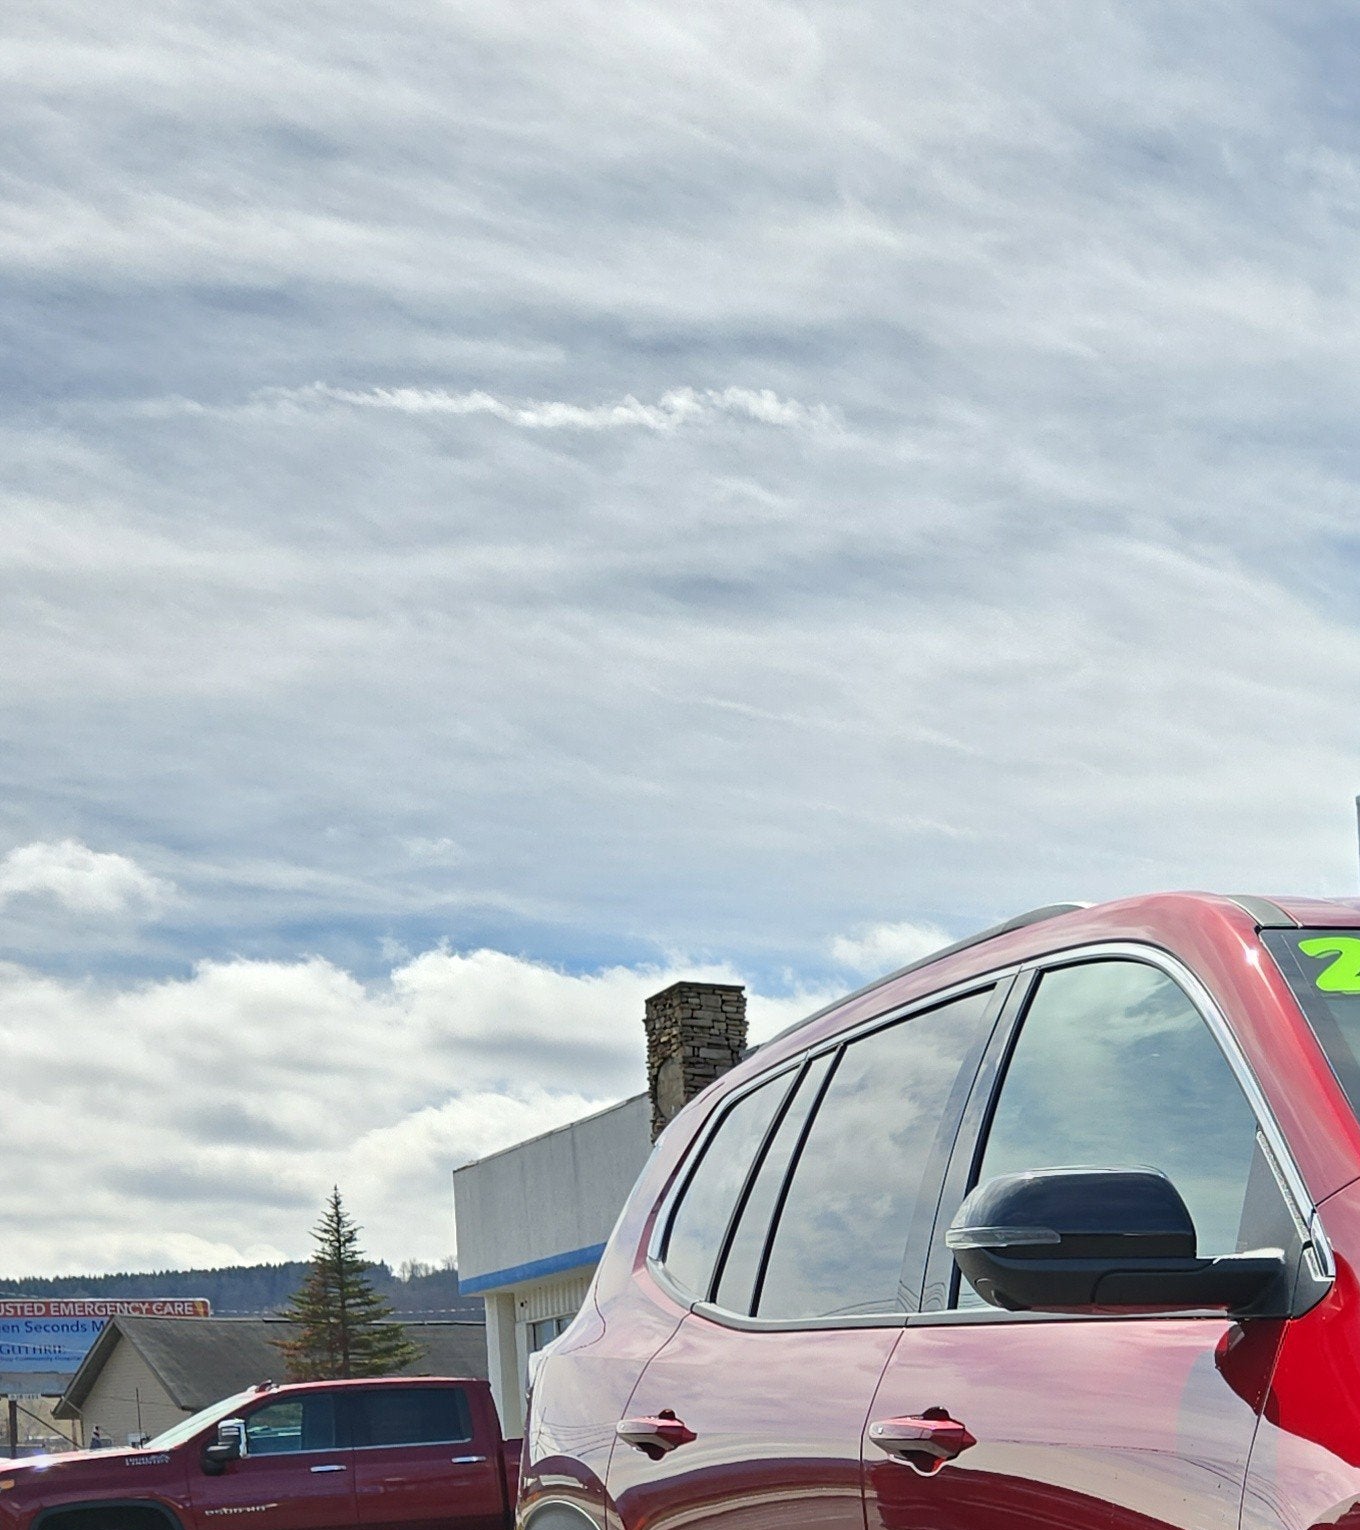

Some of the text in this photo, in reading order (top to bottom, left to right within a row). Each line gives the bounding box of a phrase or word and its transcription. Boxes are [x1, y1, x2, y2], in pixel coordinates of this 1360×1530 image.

[50, 1302, 150, 1316] EMERGENCY
[152, 1302, 194, 1315] CARE
[0, 1321, 20, 1334] en
[25, 1320, 87, 1333] Seconds
